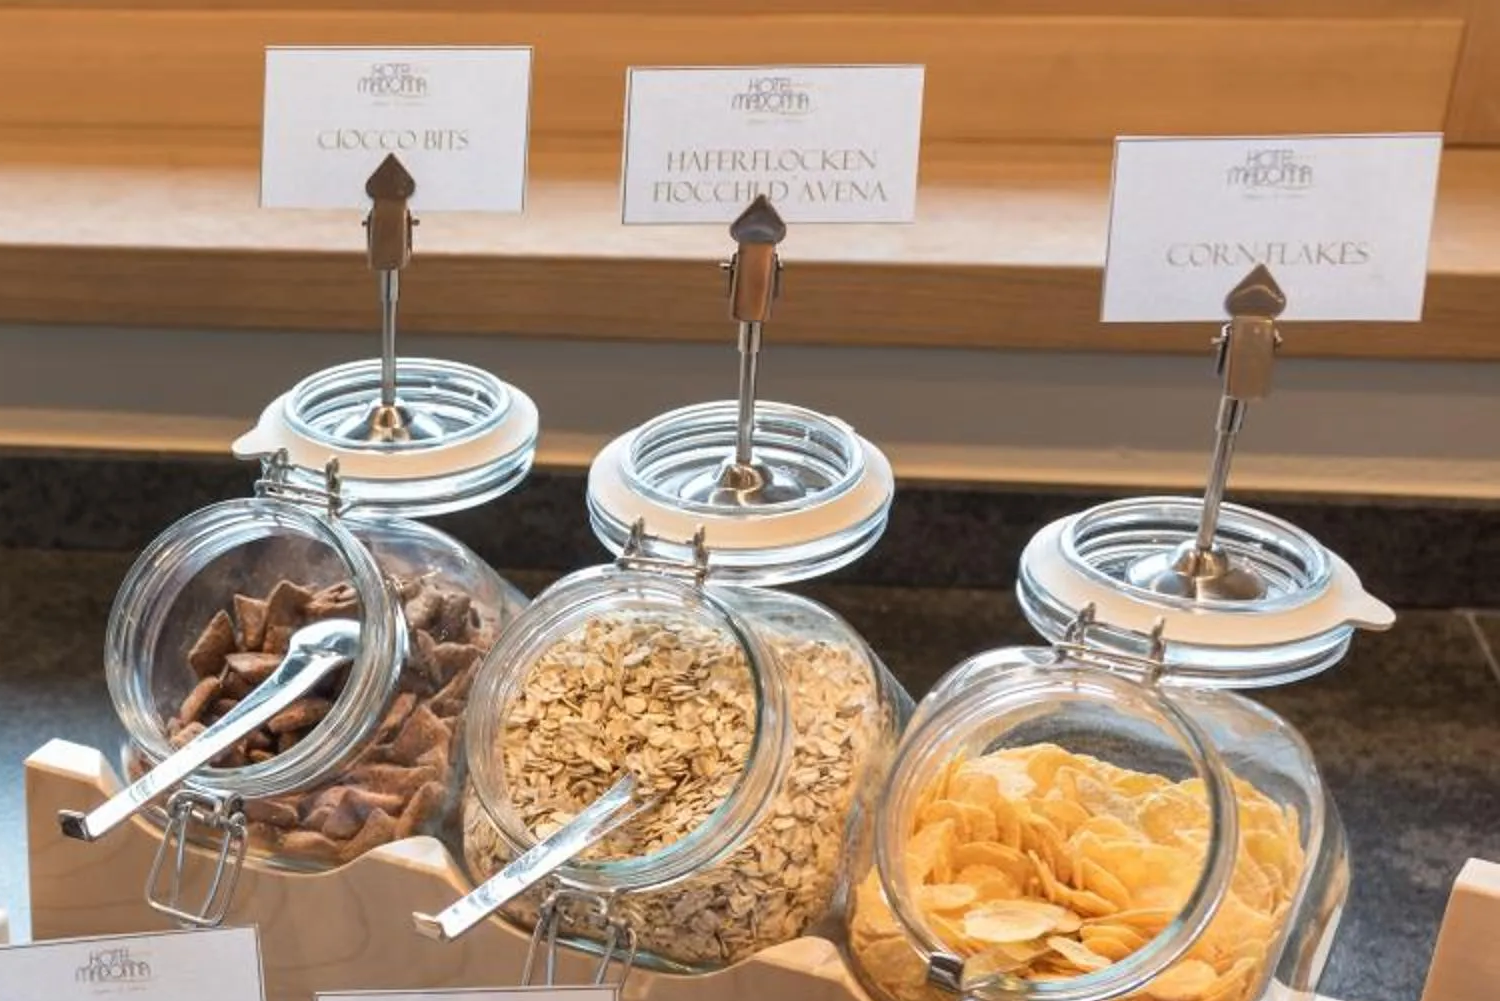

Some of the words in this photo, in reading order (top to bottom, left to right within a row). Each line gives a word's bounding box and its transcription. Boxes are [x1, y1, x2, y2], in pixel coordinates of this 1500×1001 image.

[316, 128, 417, 151] CIOCCO
[423, 128, 470, 151] BITS
[666, 148, 878, 173] HAFERFLOCKEN
[652, 180, 759, 203] FIOCCHI
